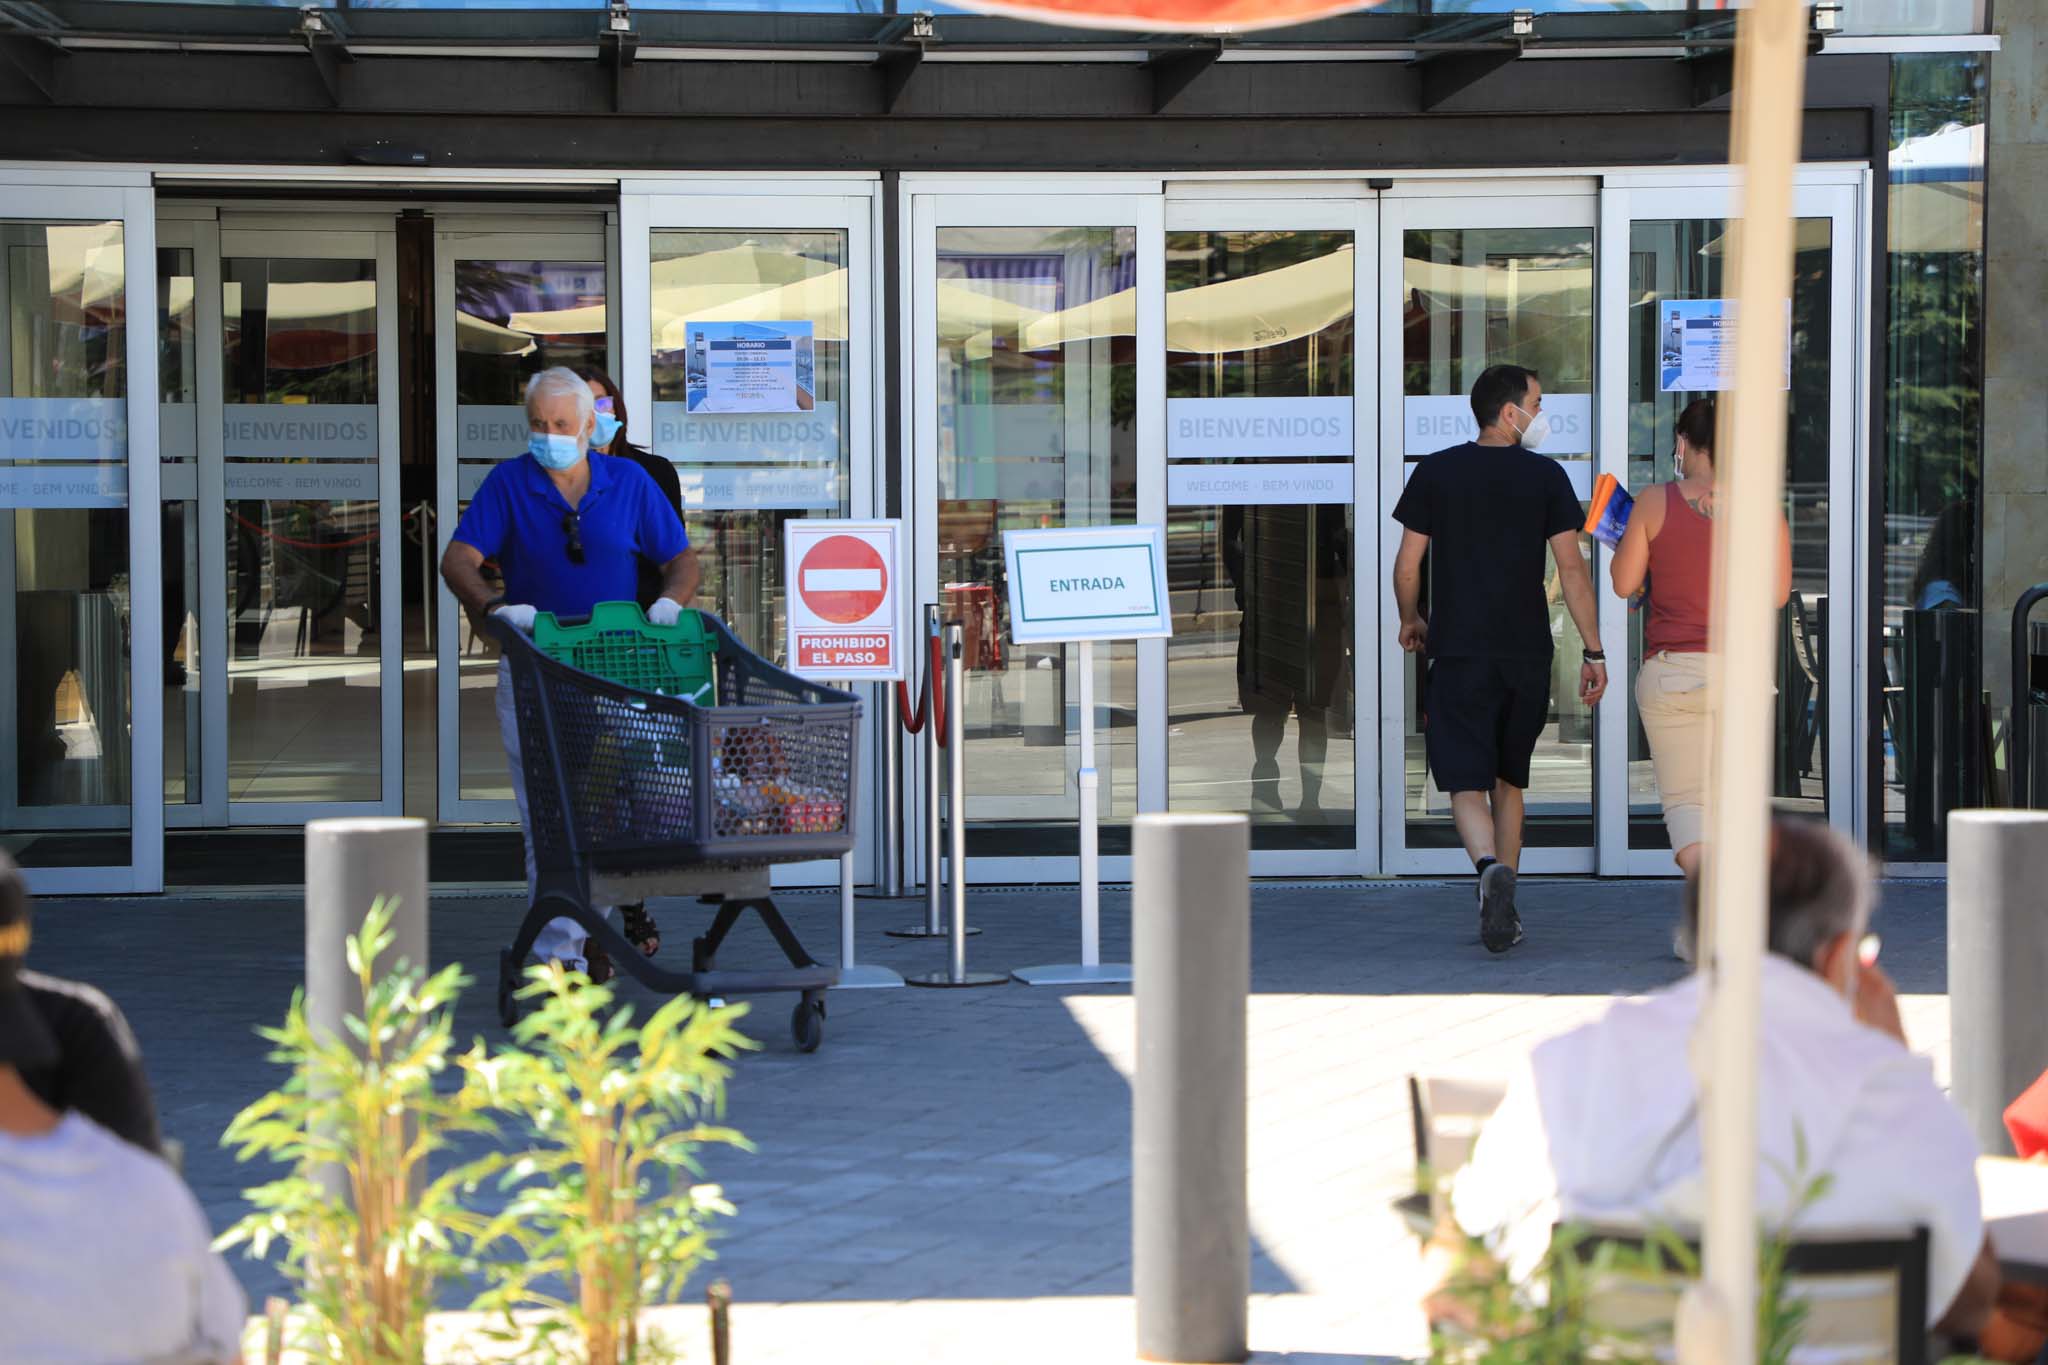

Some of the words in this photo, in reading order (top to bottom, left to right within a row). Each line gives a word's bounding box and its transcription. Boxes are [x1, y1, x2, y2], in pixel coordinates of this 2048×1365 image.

[660, 421, 827, 443] BIENVENIDOS
[1178, 416, 1342, 439] BIENVENIDOS
[1187, 480, 1249, 492] WELCOME
[1262, 479, 1290, 491] BEM
[1292, 479, 1334, 491] VINDO
[1049, 576, 1126, 593] ENTRADA
[801, 636, 887, 649] PROHIBIDO
[812, 652, 832, 664] EL
[835, 651, 877, 664] PASO
